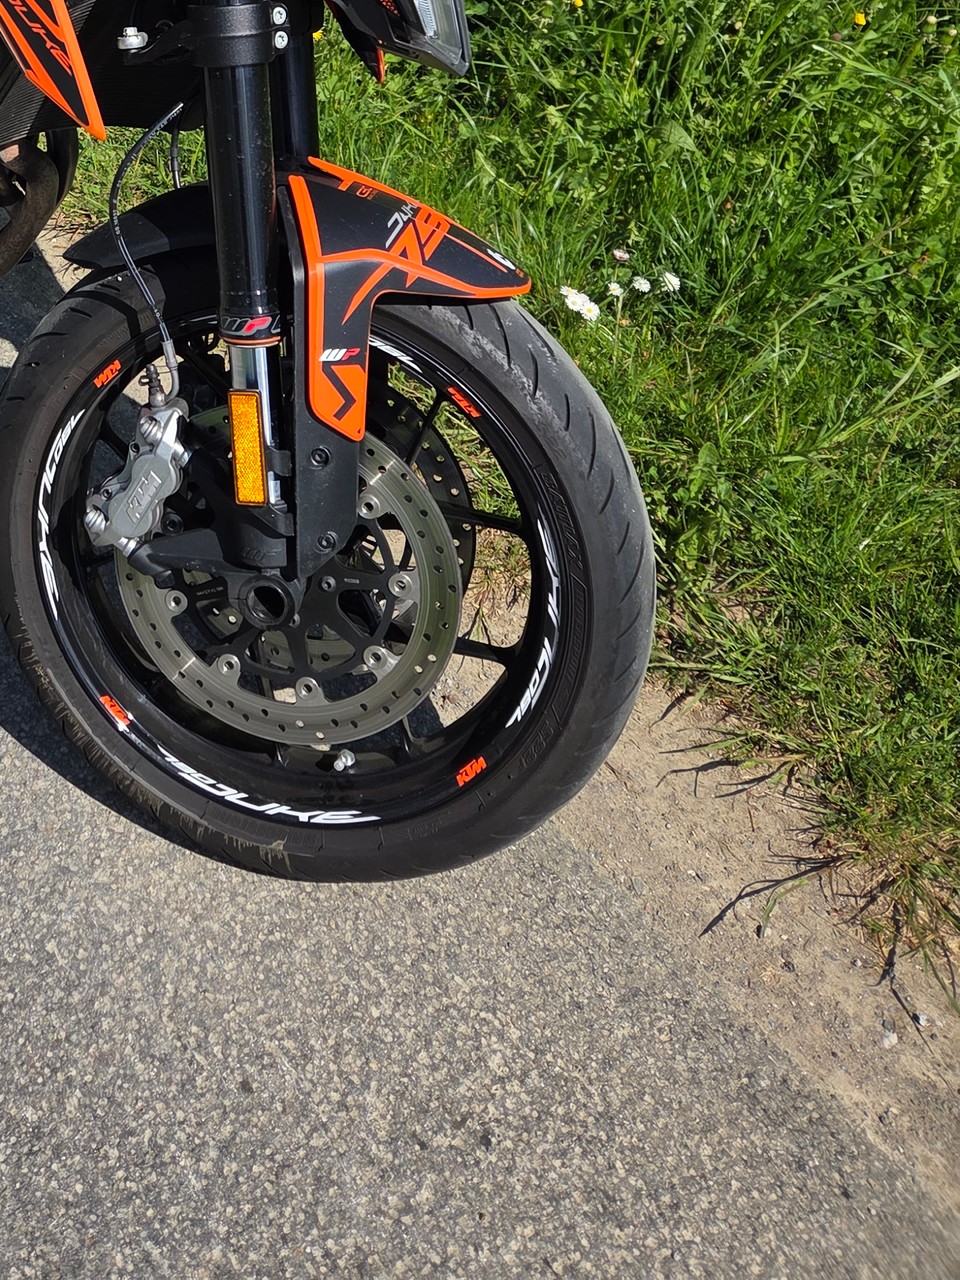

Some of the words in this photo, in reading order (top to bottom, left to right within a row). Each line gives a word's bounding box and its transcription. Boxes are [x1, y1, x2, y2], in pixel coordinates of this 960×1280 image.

[318, 347, 361, 362] WP
[93, 359, 121, 389] KTM
[446, 386, 482, 419] KTM
[455, 754, 487, 788] KTM
